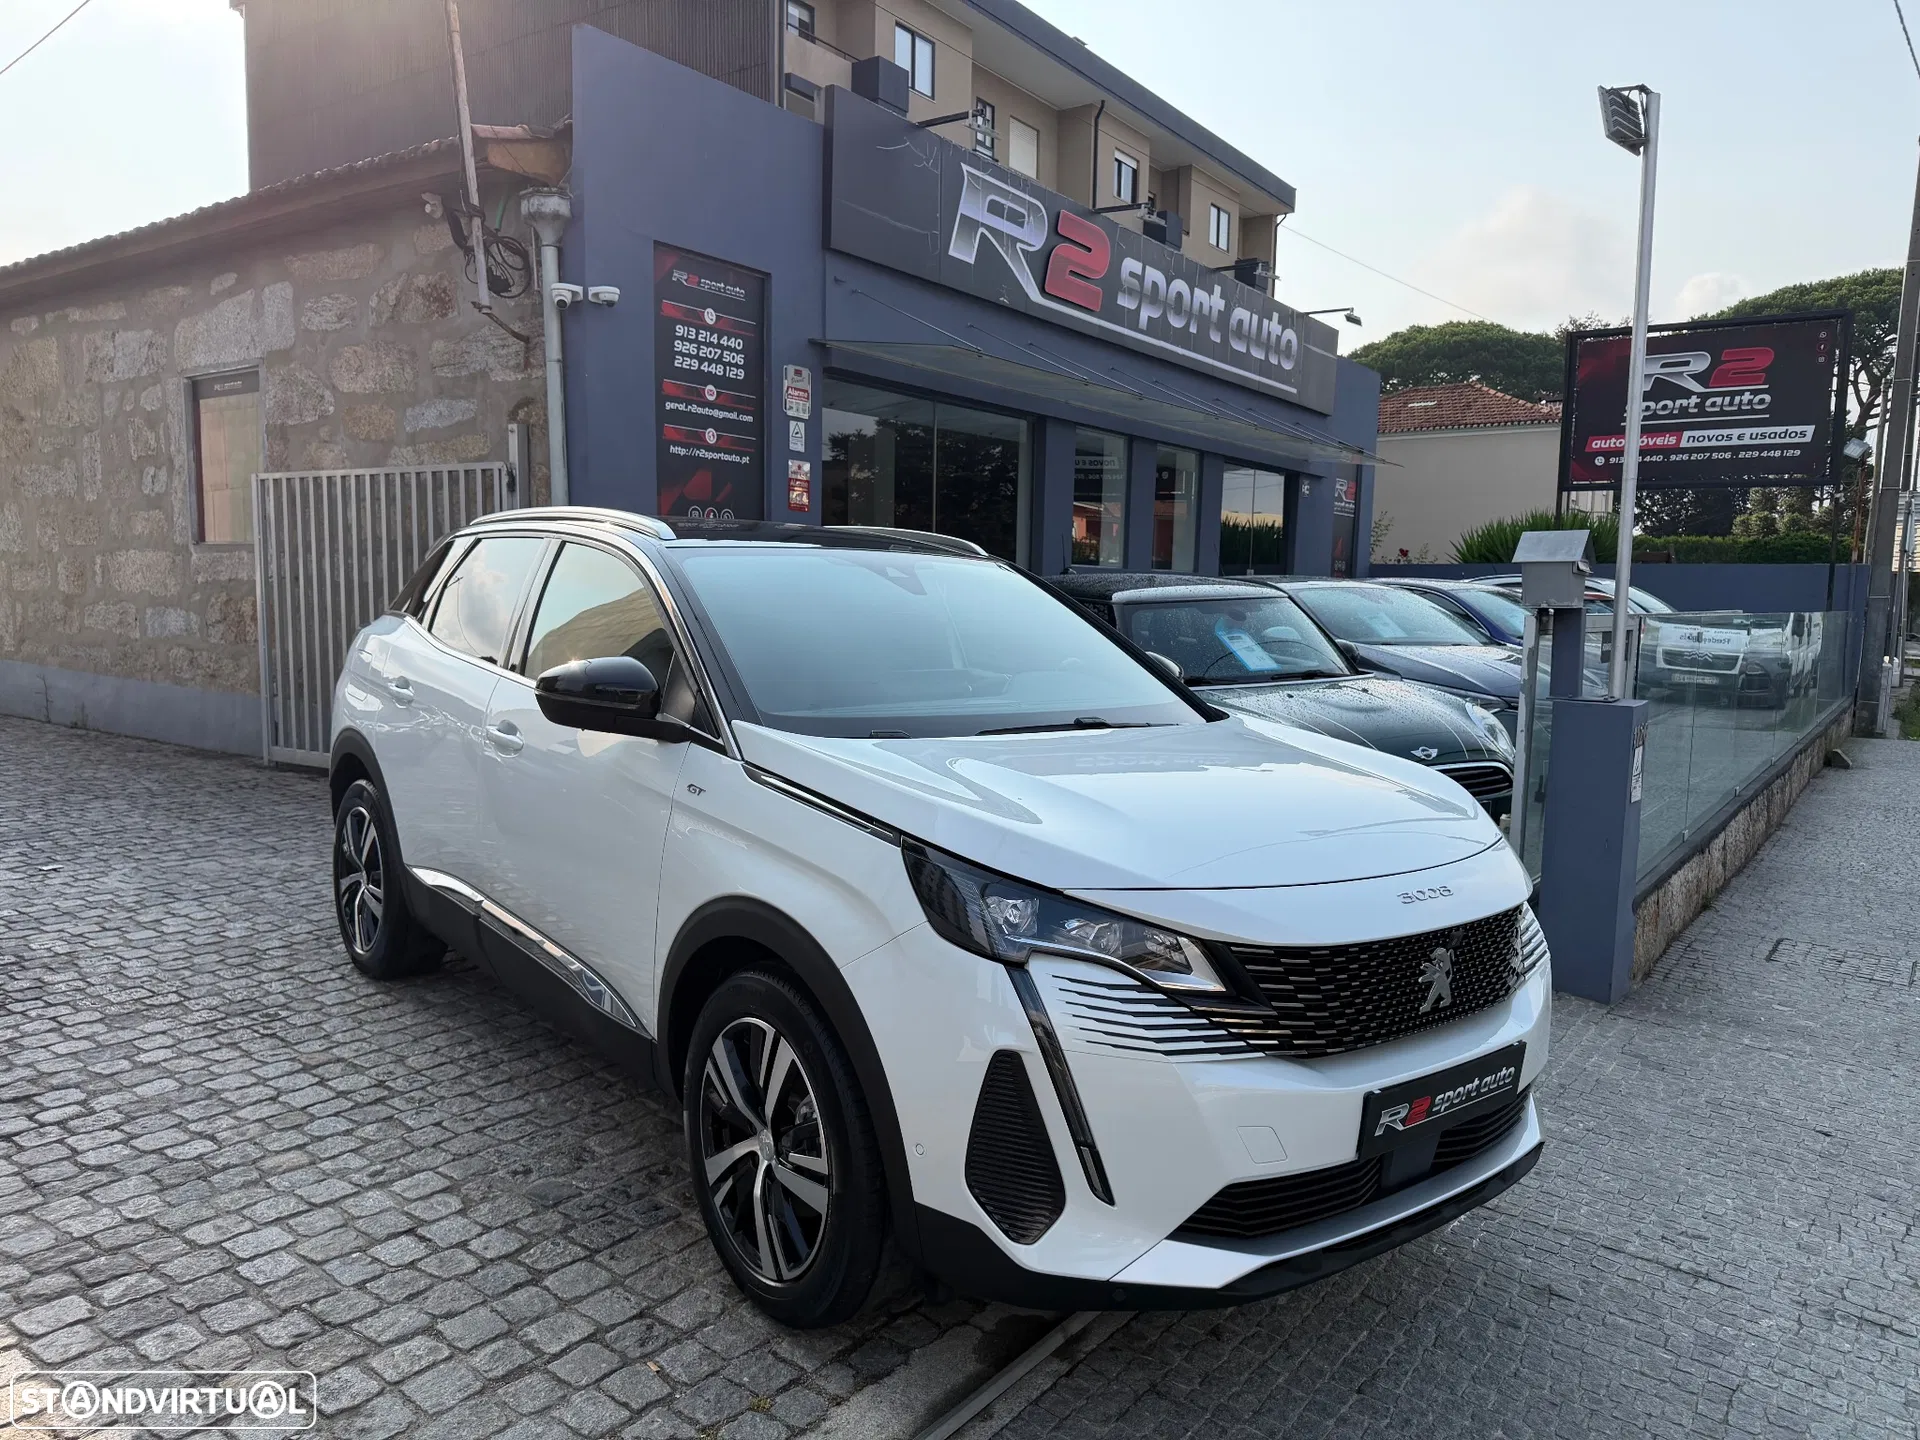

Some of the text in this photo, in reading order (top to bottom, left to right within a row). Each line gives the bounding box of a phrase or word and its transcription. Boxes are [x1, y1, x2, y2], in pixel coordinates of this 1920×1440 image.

[949, 162, 1297, 370] R2 sport auto
[672, 269, 746, 298] R2 sport auto
[675, 324, 743, 350] 913 214 440
[674, 340, 745, 365] 926 207 506
[674, 355, 745, 380] 229 448 129
[1643, 347, 1775, 393] R2
[665, 401, 754, 422] geral.r2auto@gmail.com
[1624, 391, 1772, 420] port auto
[1591, 434, 1677, 449] autoóveis
[1686, 428, 1808, 443] novos e usados
[669, 444, 750, 465] http://r2sportauto.pt
[1643, 455, 1663, 463] 440
[1669, 453, 1689, 462] 926
[1691, 452, 1710, 460] 207
[1711, 452, 1732, 460] 506
[1738, 450, 1759, 458] 229
[1760, 449, 1781, 457] 448
[686, 783, 706, 796] GT
[1397, 885, 1454, 905] 3008
[1374, 1066, 1516, 1137] R2 sport auto
